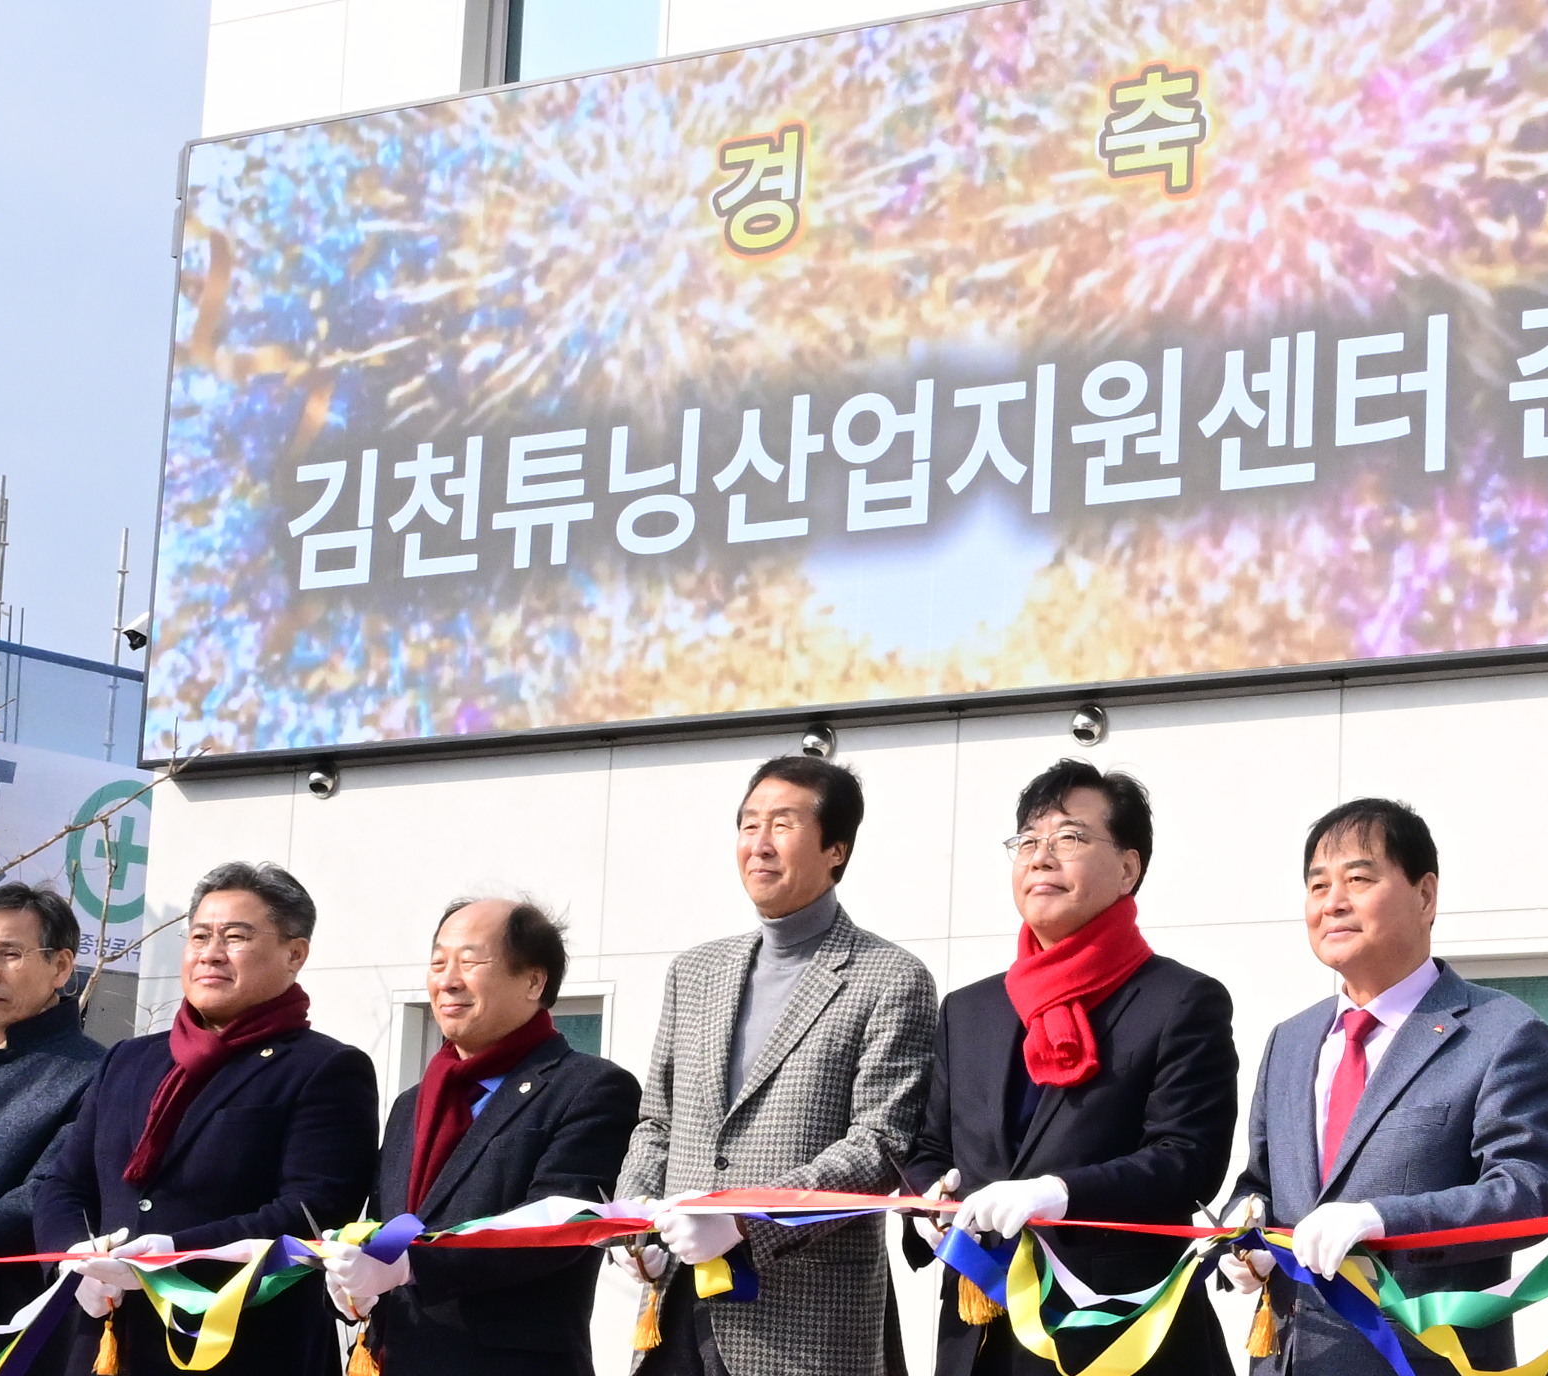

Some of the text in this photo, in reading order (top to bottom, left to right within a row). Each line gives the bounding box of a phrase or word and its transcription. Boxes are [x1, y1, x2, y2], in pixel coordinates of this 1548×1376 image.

[715, 67, 1205, 253] 경 축
[285, 314, 1448, 591] 김천튜닝산업지원센터
